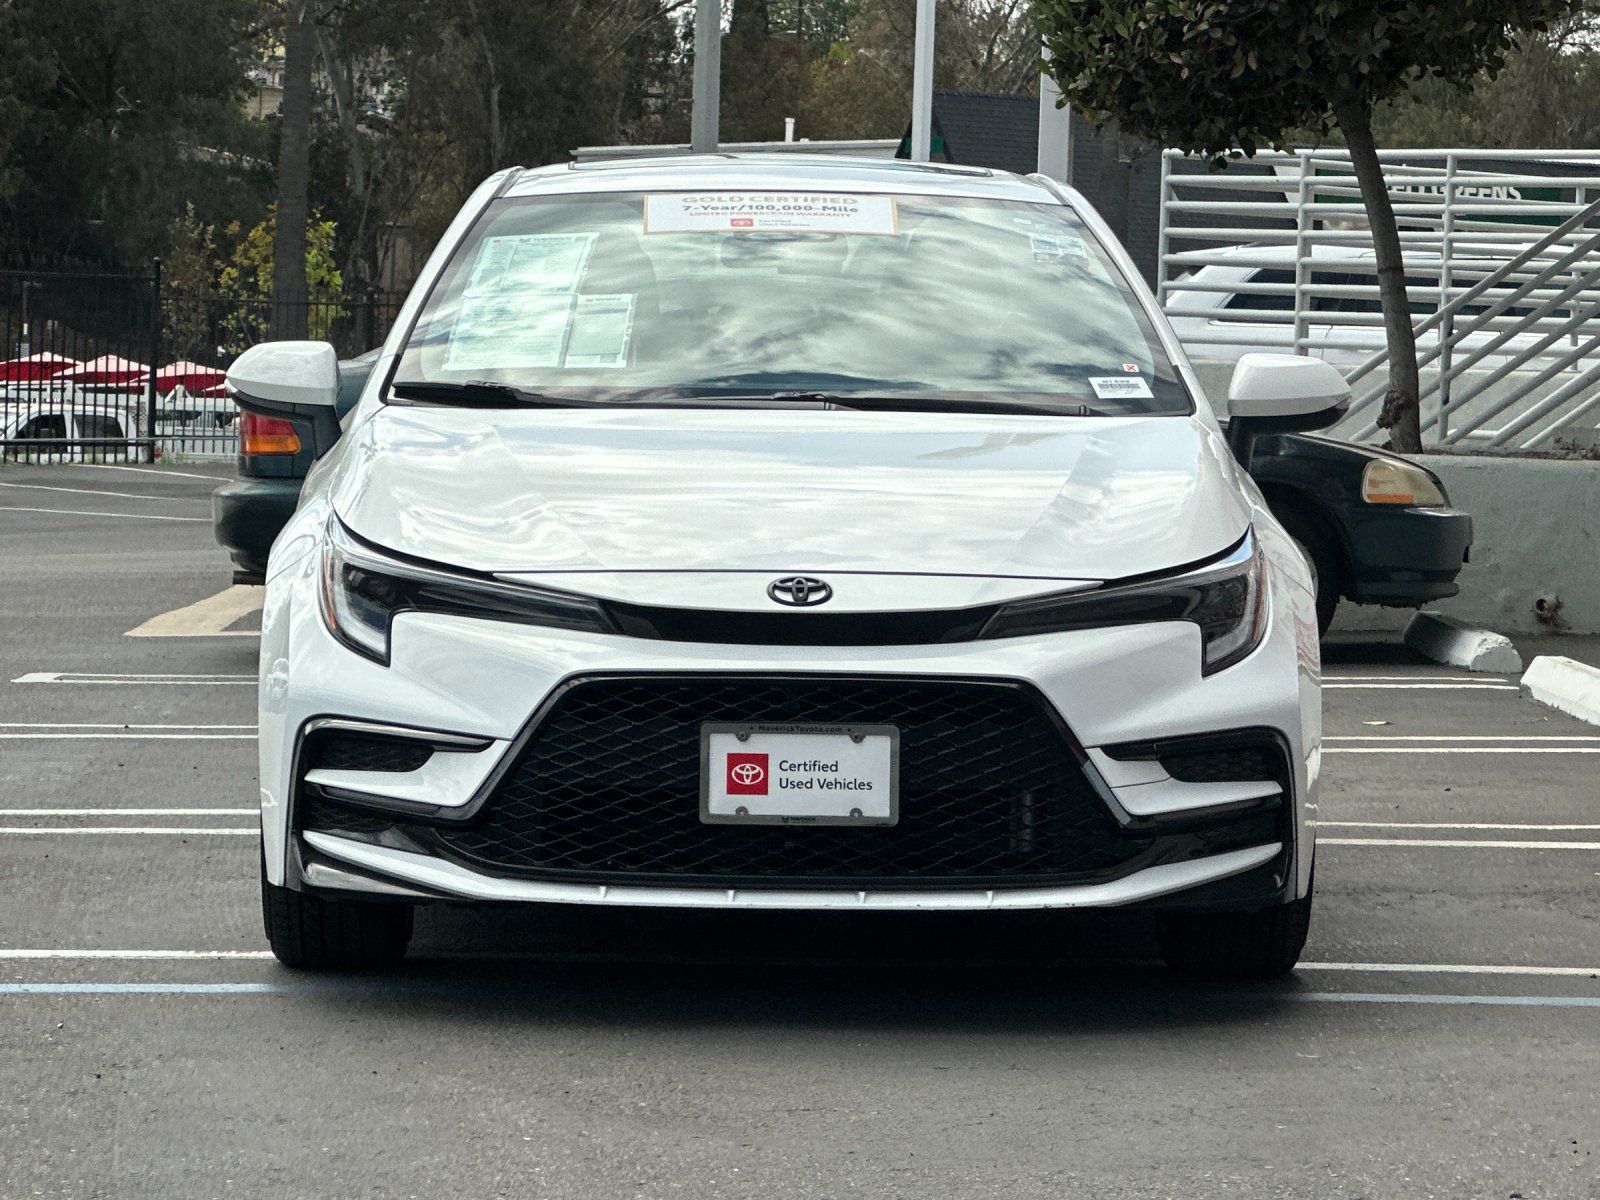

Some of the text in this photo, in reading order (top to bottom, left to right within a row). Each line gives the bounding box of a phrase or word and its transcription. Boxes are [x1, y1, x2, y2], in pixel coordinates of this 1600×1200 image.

[682, 195, 859, 205] GOLD CERTIFIED
[681, 204, 859, 213] 7-Year/100,000-Mile
[758, 725, 843, 733] MaverickToyota.com
[779, 760, 839, 773] Certified
[779, 777, 873, 791] Used Vehicles
